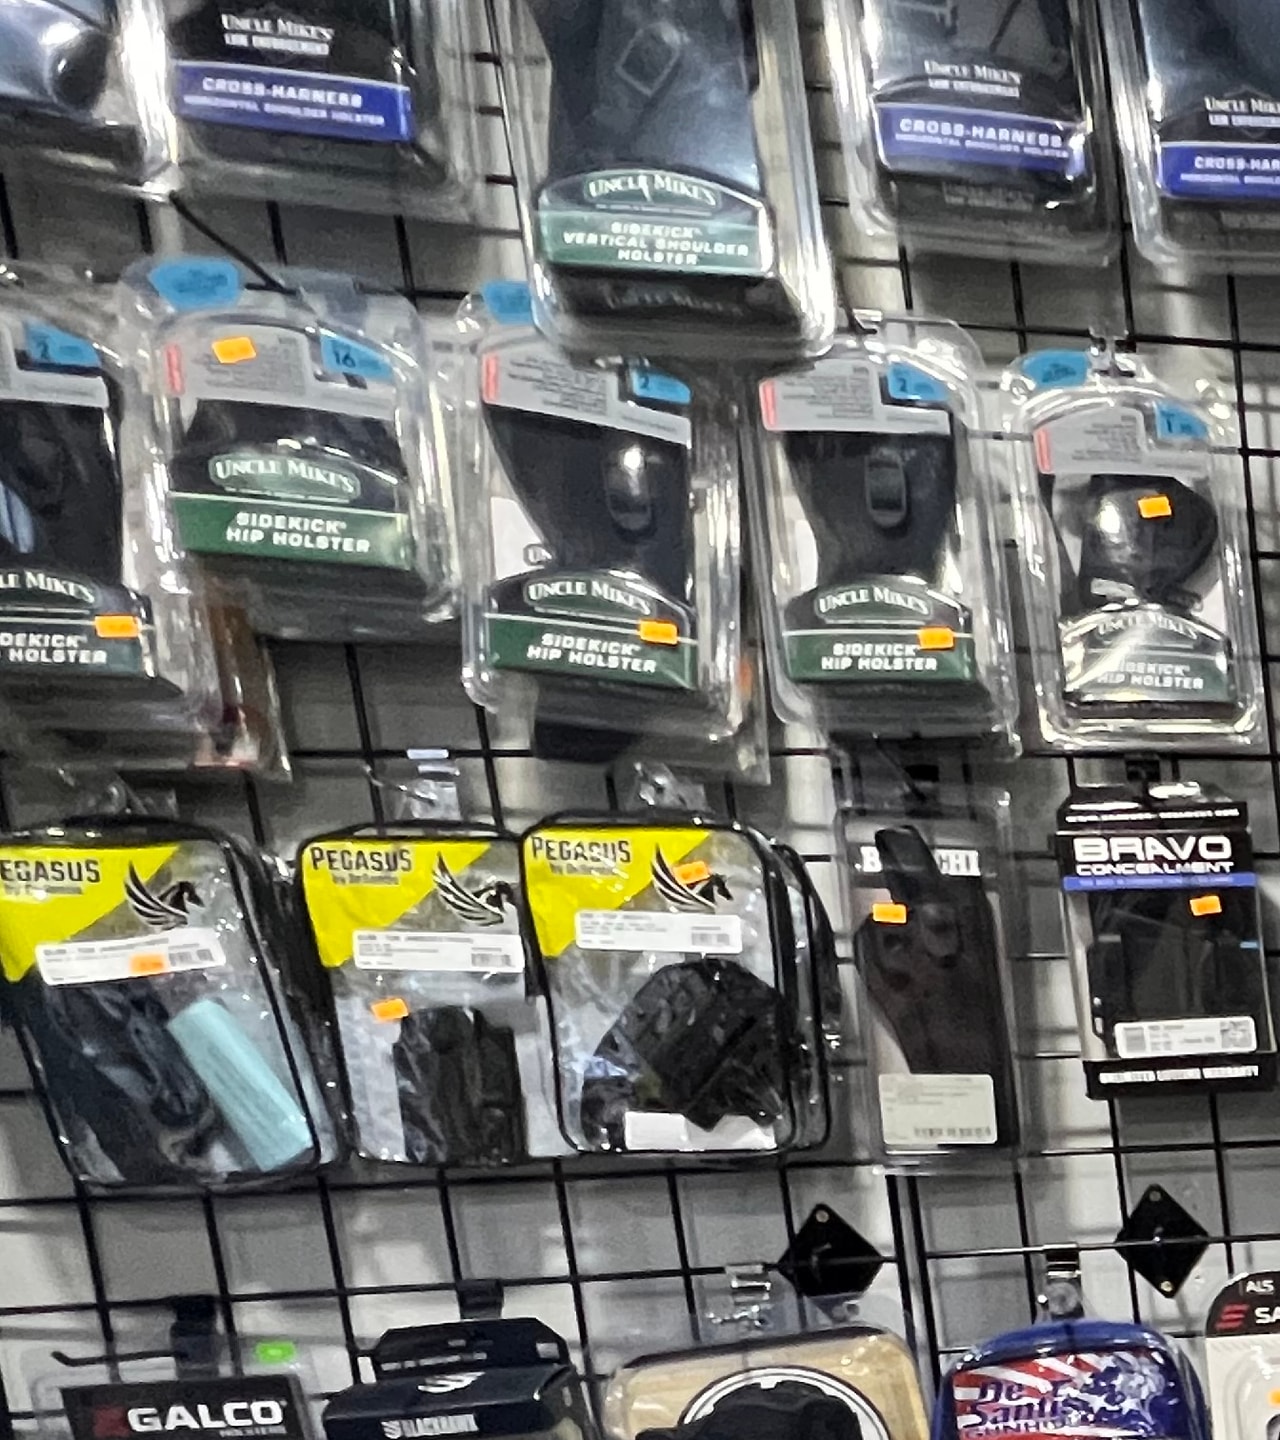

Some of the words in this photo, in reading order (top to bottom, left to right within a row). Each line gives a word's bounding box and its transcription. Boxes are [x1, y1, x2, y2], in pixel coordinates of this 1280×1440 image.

[203, 77, 362, 108] CROSS-HARNESS
[899, 118, 1062, 147] CROSS-HARNESS
[564, 232, 648, 249] VERTICAL
[655, 239, 749, 257] SHOULDER
[618, 249, 697, 265] HOLSTER
[214, 459, 282, 480] UNCLE
[236, 512, 347, 533] SIDEKICK
[227, 527, 264, 543] HIP
[273, 532, 370, 552] HOLSTER
[528, 579, 585, 601] UNCLE
[819, 589, 871, 613] UNCLE
[0, 632, 88, 648] DEKICK
[541, 633, 640, 655] SIDEKICK
[832, 642, 918, 655] SIDEKICK
[9, 648, 108, 665] HOLSTER
[527, 646, 566, 662] HIP
[571, 651, 657, 673] HOLSTER
[821, 656, 853, 671] HIP
[858, 656, 938, 671] HOLSTER
[1120, 661, 1190, 675] IDEKICK
[310, 846, 412, 871] PEGASUS
[531, 836, 631, 863] PEGASUS
[1072, 835, 1232, 862] BRAVO
[0, 859, 101, 886] EGASUS
[1075, 861, 1235, 876] CONCEALMENT
[1246, 1279, 1274, 1294] ALS
[127, 1400, 284, 1433] GALCO
